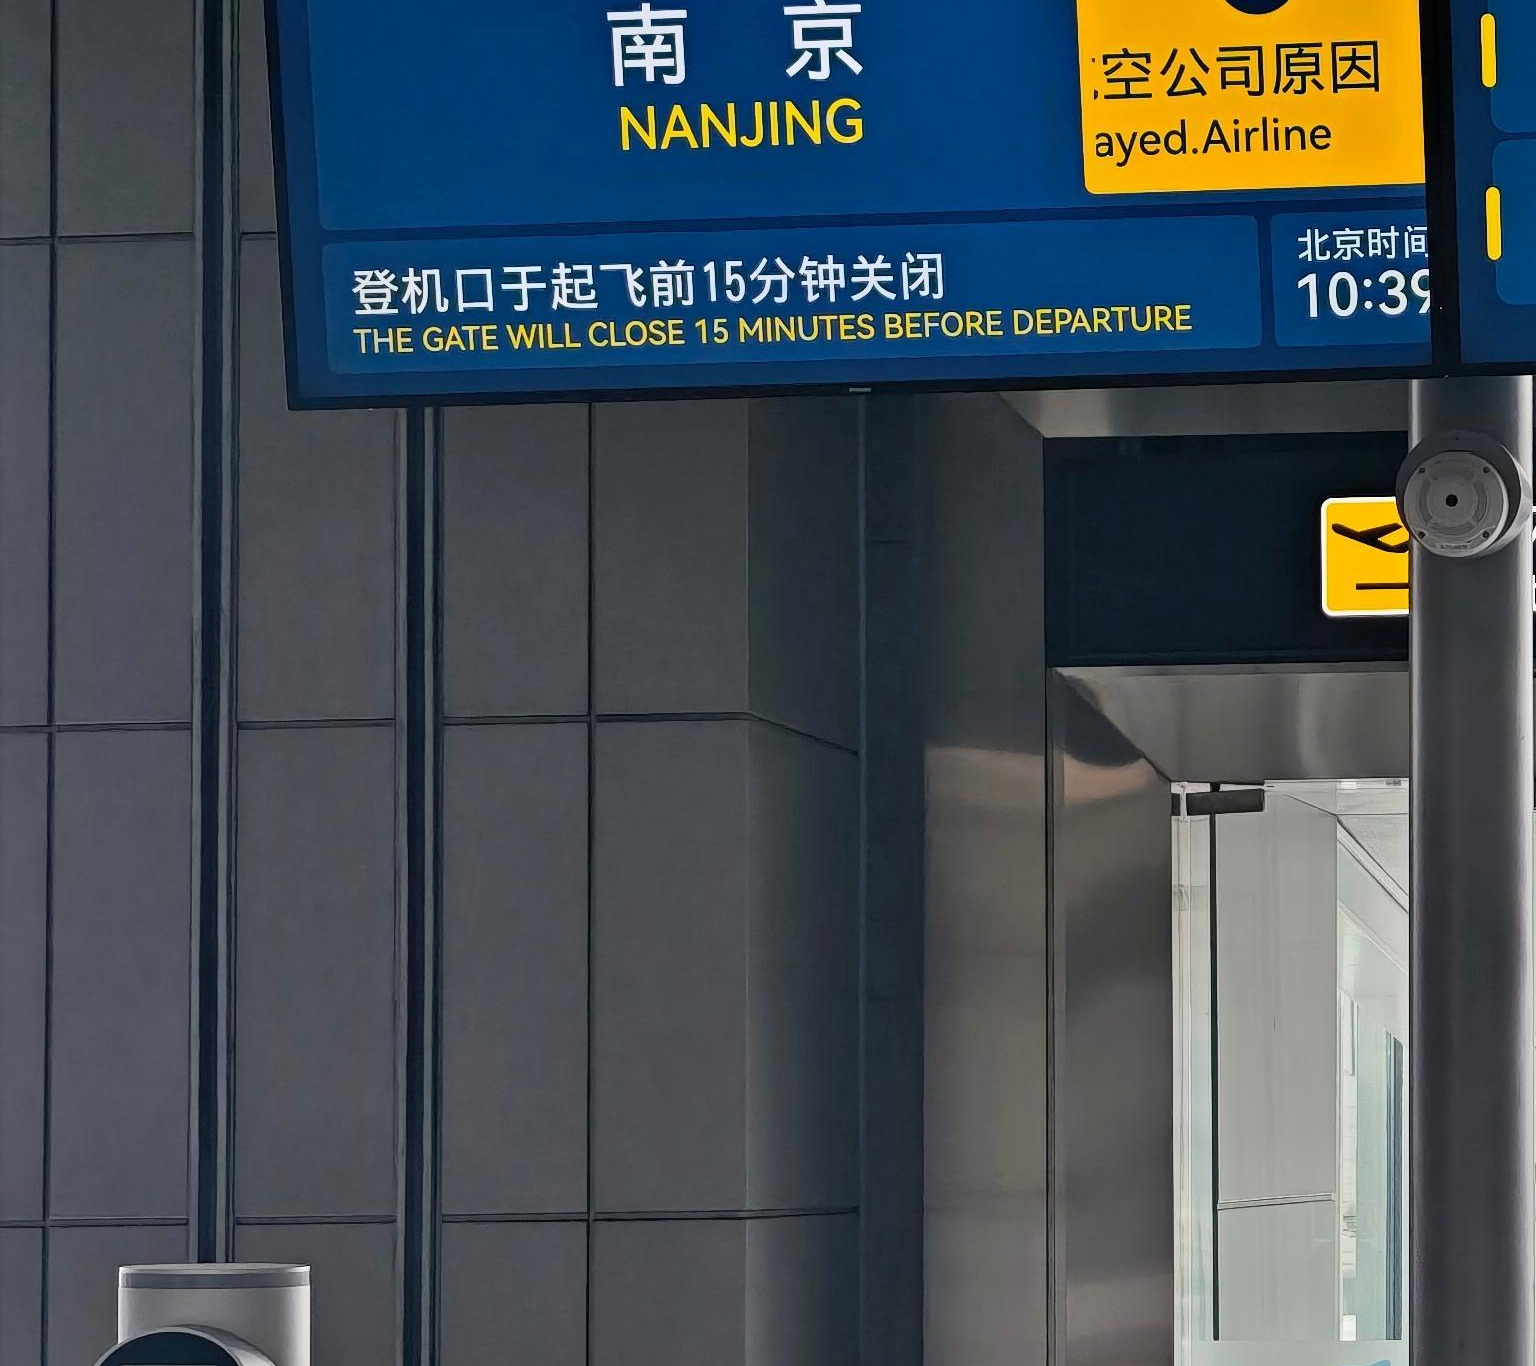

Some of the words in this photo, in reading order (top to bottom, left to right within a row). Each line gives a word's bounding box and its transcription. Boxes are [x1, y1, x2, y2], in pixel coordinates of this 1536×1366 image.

[1091, 40, 1380, 100] 空公司原因
[620, 98, 863, 151] NANJING
[1095, 116, 1332, 168] ayed.Airline
[1297, 225, 1427, 262] 北京时间
[351, 251, 944, 315] 登机口于起飞前15分钟关闭
[1297, 268, 1430, 318] 10:39
[352, 326, 414, 354] THE
[422, 324, 499, 352] GATE
[505, 322, 582, 350] WILL
[588, 318, 686, 347] CLOSE
[695, 318, 729, 344] 15
[739, 313, 875, 343] MINUTES
[884, 309, 1004, 339] BEFORE
[1013, 303, 1193, 335] DEPARTURE
